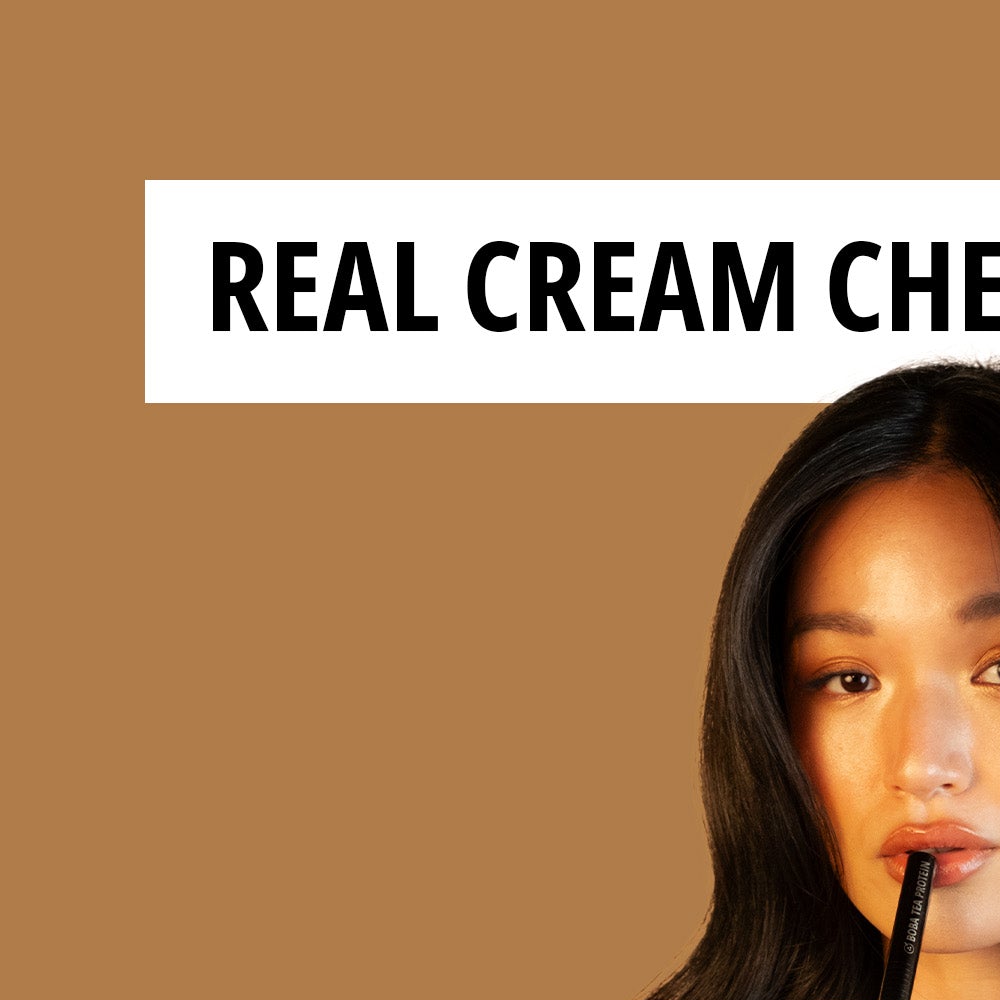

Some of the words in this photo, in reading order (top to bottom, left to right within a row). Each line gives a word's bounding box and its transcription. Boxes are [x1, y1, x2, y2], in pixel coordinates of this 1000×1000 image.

[914, 860, 931, 898] PROTEIN
[911, 900, 923, 915] TEA
[906, 918, 920, 942] BOBA
